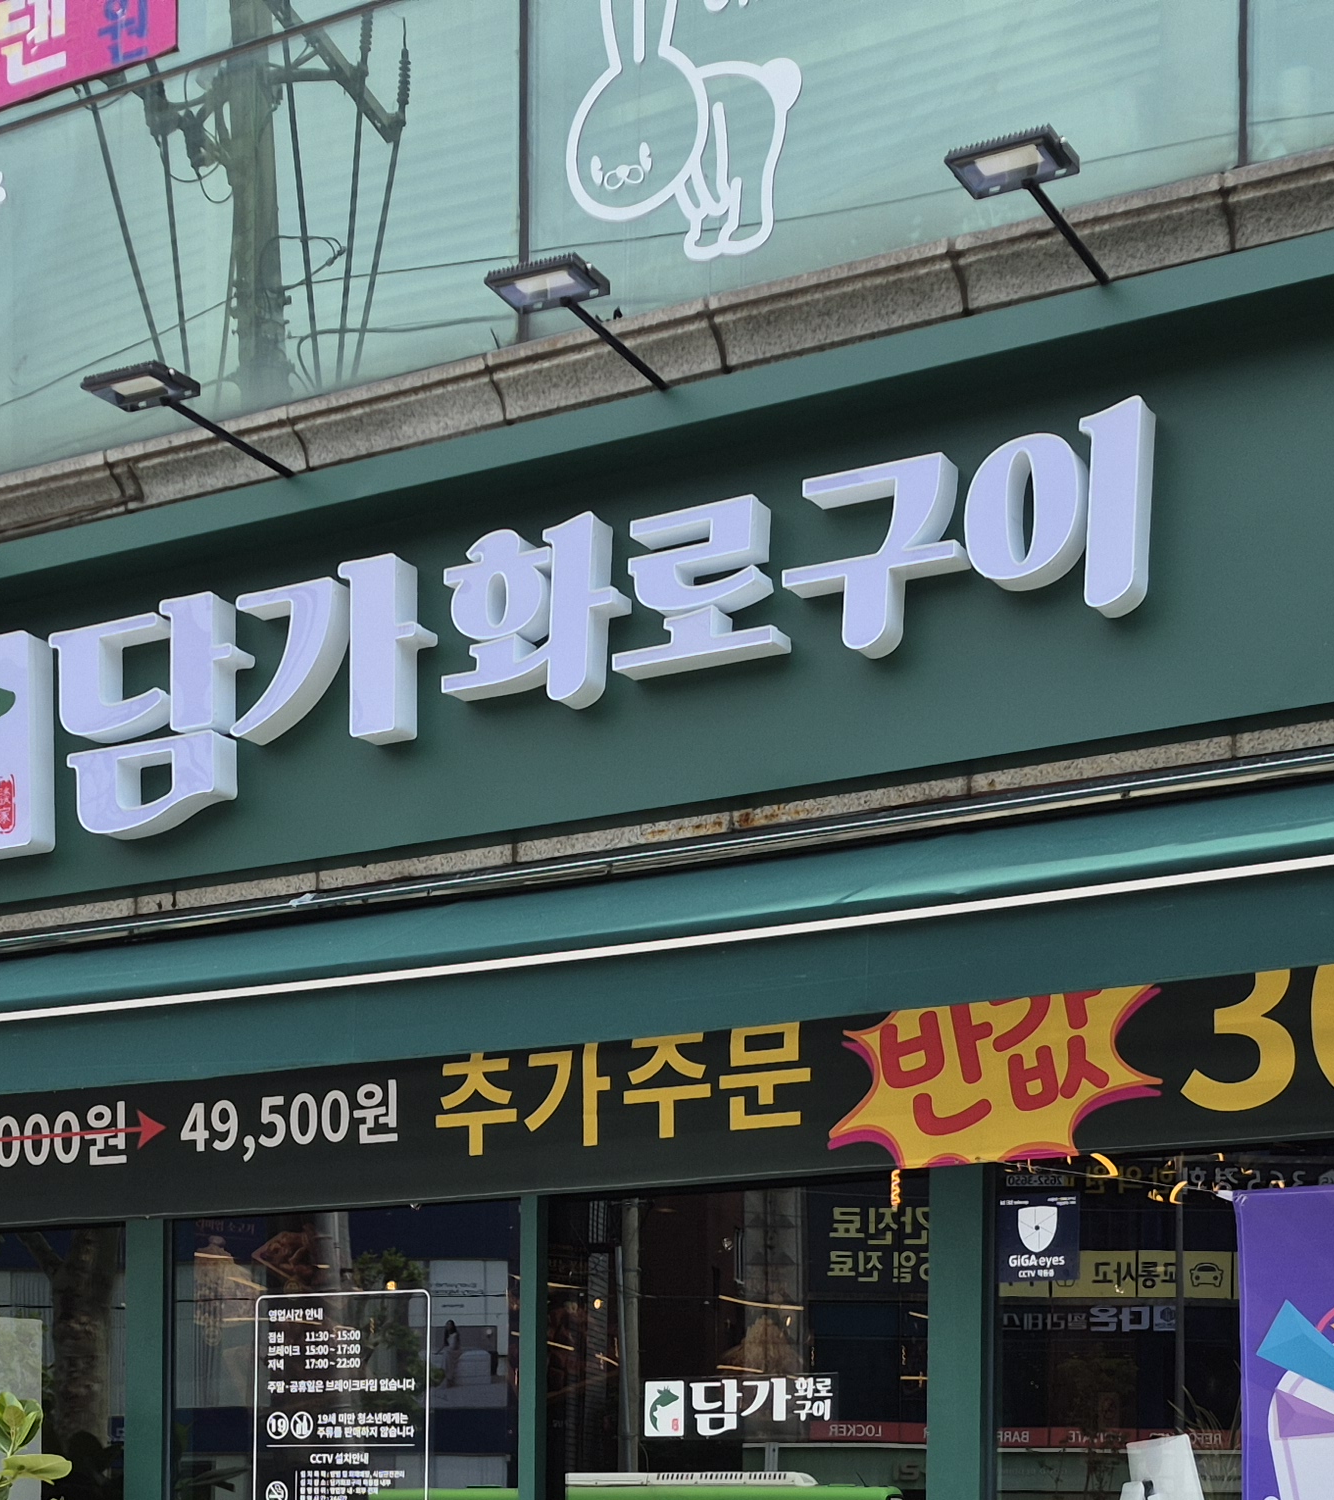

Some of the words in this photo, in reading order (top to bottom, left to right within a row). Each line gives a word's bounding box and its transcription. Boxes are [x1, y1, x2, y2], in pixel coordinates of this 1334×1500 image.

[179, 1078, 400, 1162] 49,500원
[268, 1308, 304, 1322] 영업시간
[305, 1307, 323, 1321] 안내
[267, 1331, 285, 1344] 점심
[304, 1331, 329, 1342] 11:30
[336, 1330, 361, 1342] 15:00
[267, 1345, 301, 1357] 브레이크
[304, 1344, 329, 1356] 15:00
[336, 1344, 361, 1355] 17:00
[267, 1359, 285, 1371] 저녁
[304, 1358, 329, 1370] 17:00
[336, 1357, 361, 1369] 22:00
[325, 1378, 378, 1393] 브레이크타임
[379, 1377, 416, 1391] 없습니다
[793, 1376, 833, 1399] 화로
[691, 1376, 792, 1437] 담가
[793, 1398, 832, 1422] 구이
[317, 1413, 337, 1425] 19세
[338, 1413, 356, 1425] 미만
[379, 1425, 415, 1438] 않습니다
[309, 1453, 333, 1464] CCTV
[335, 1452, 369, 1465] 설치안내
